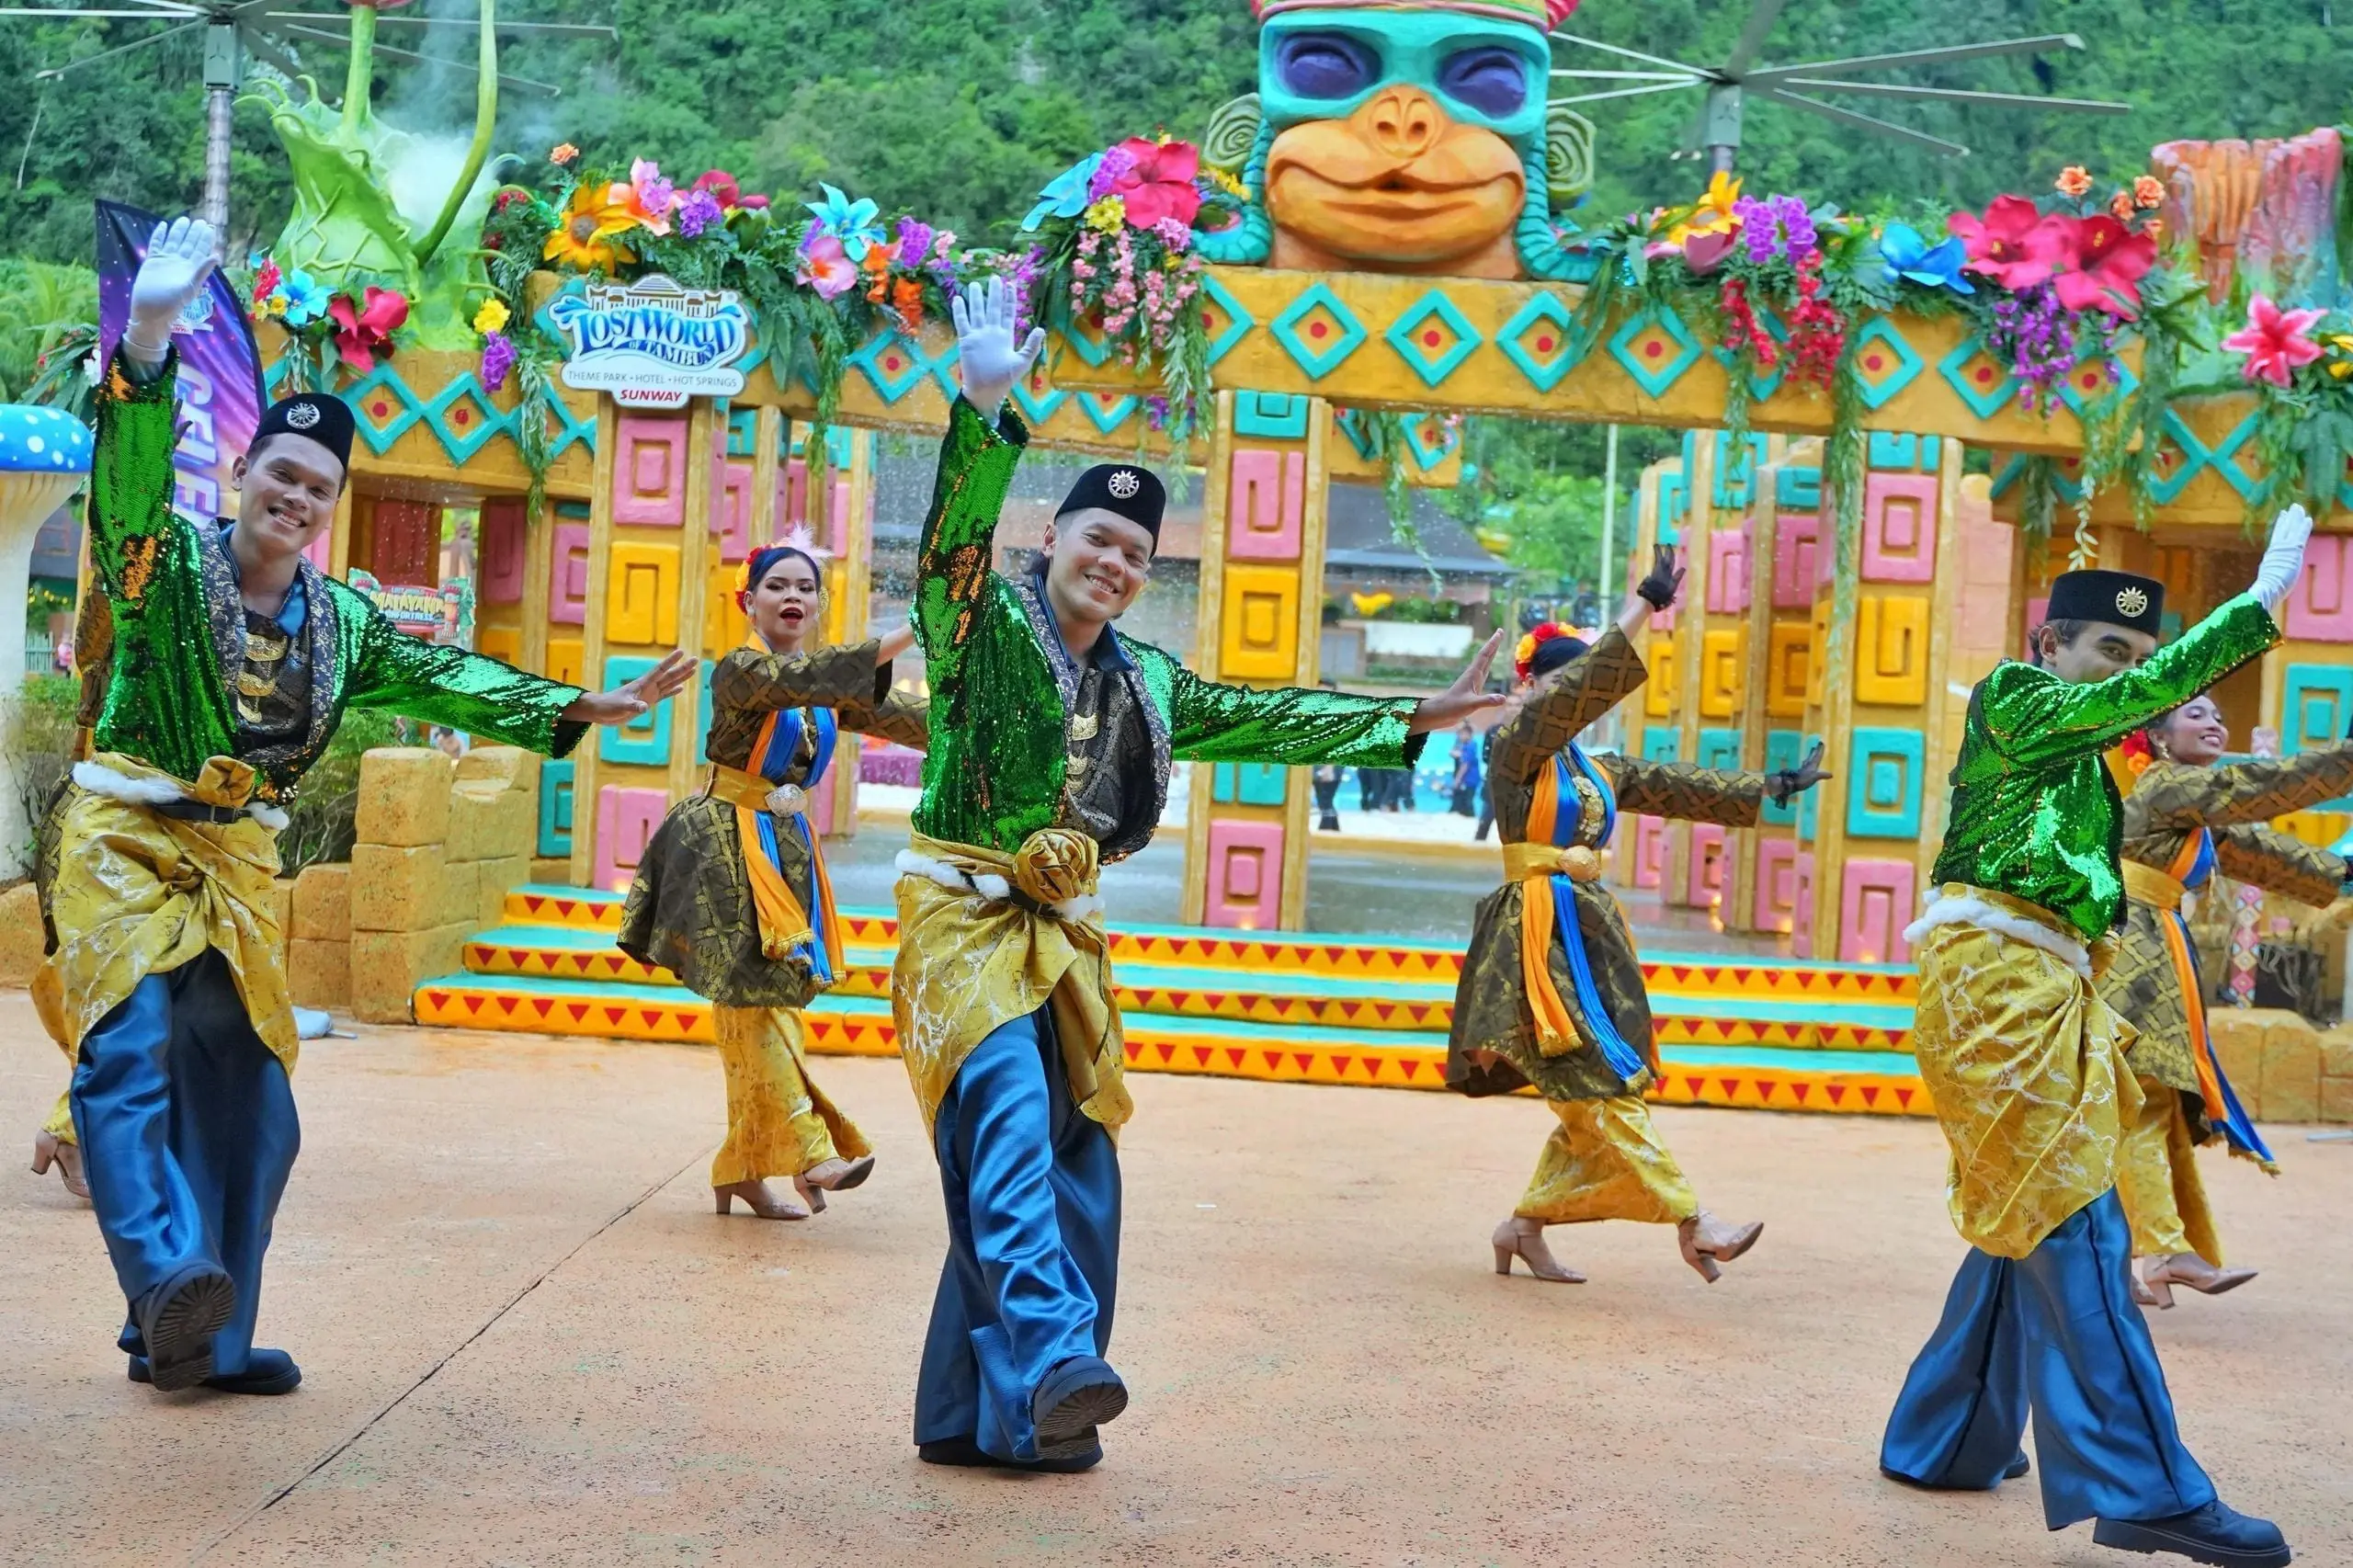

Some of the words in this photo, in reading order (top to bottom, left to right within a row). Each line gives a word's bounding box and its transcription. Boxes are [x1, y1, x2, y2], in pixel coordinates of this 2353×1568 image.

[639, 309, 735, 355] WORLD
[645, 342, 715, 366] TAMBUN
[567, 370, 600, 381] THEME
[603, 372, 627, 382] PARK
[635, 373, 665, 384] HOTEL
[673, 375, 694, 385] HOT
[696, 376, 737, 387] SPRINGS
[620, 389, 683, 402] SUNWAY
